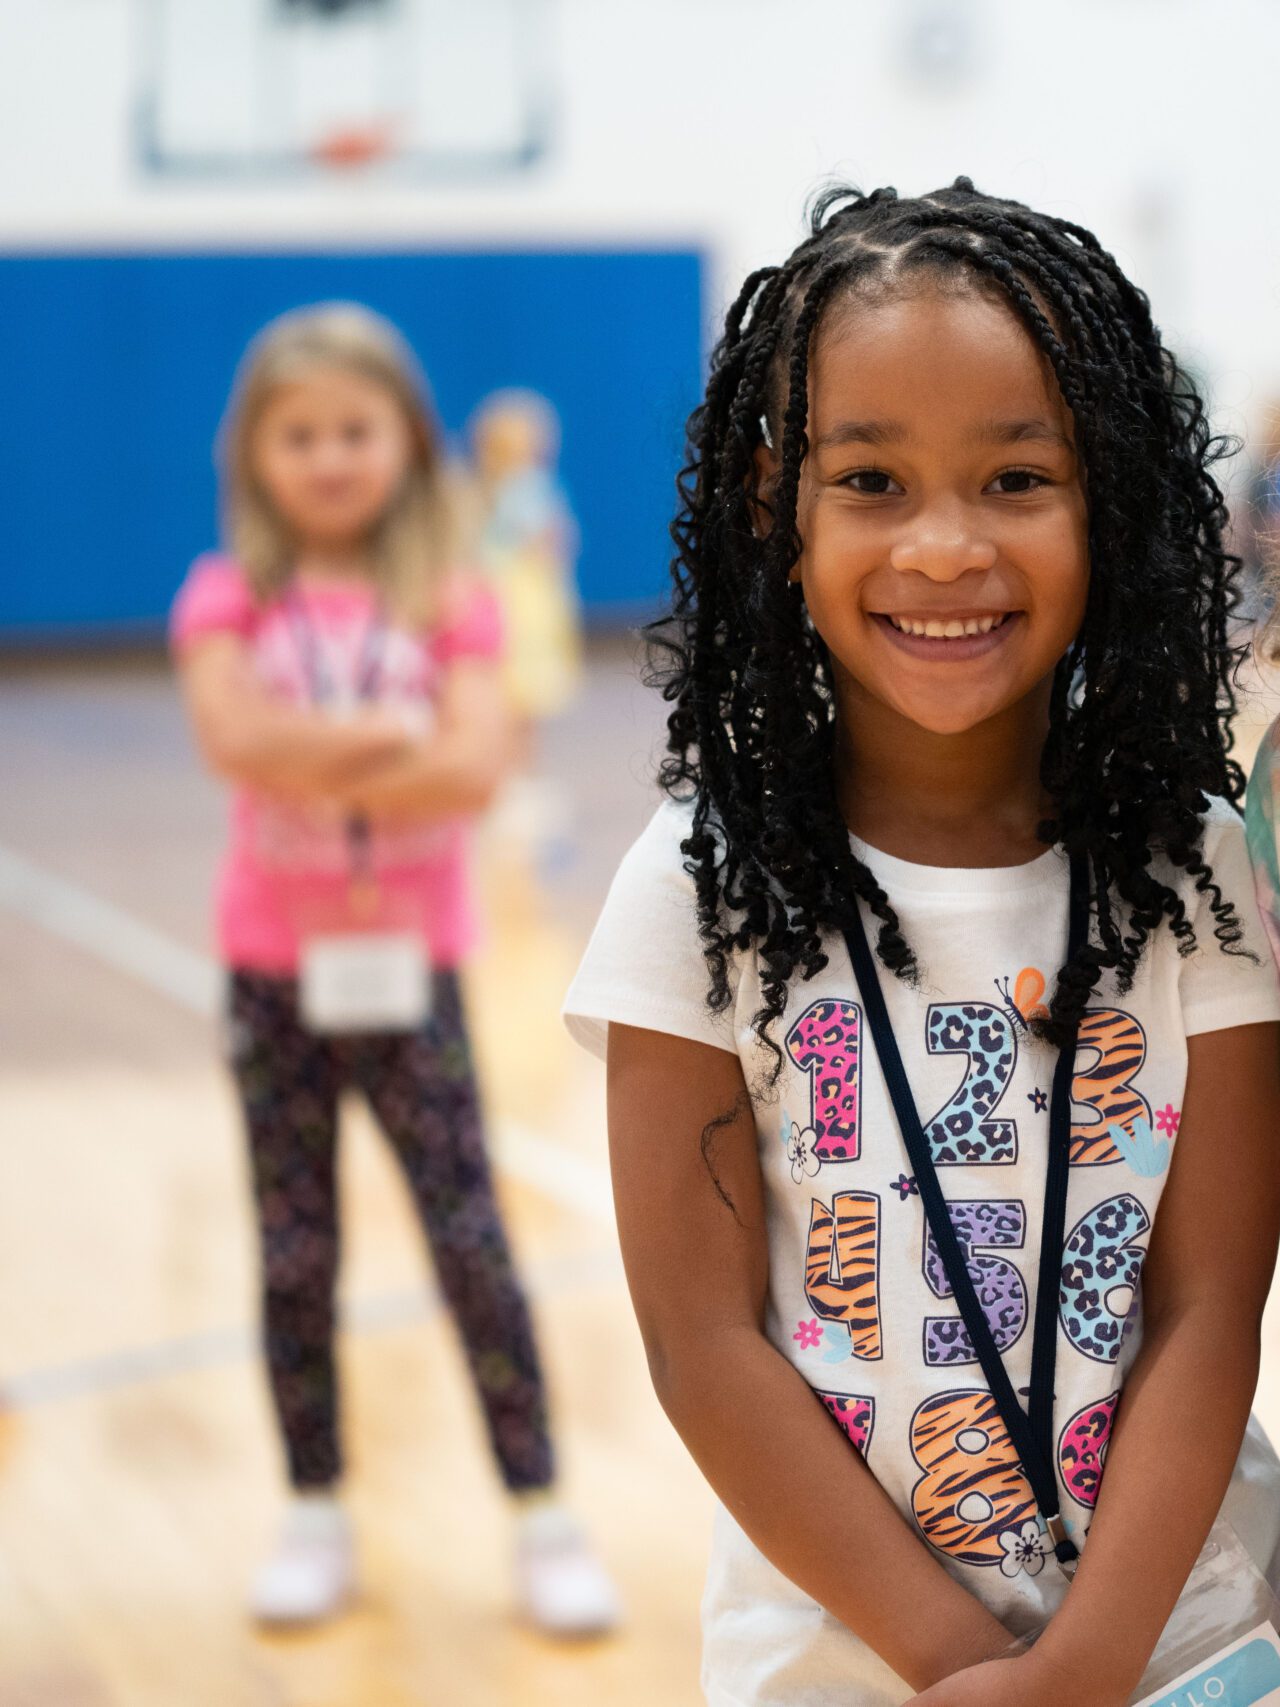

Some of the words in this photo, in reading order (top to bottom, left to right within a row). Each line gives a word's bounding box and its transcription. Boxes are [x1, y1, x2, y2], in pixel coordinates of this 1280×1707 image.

[784, 998, 863, 1163] 1
[924, 1001, 1018, 1166] 2
[804, 1190, 883, 1361] 4
[922, 1199, 1029, 1367] 5
[1058, 1193, 1151, 1364] 6
[910, 1388, 1039, 1567] 8
